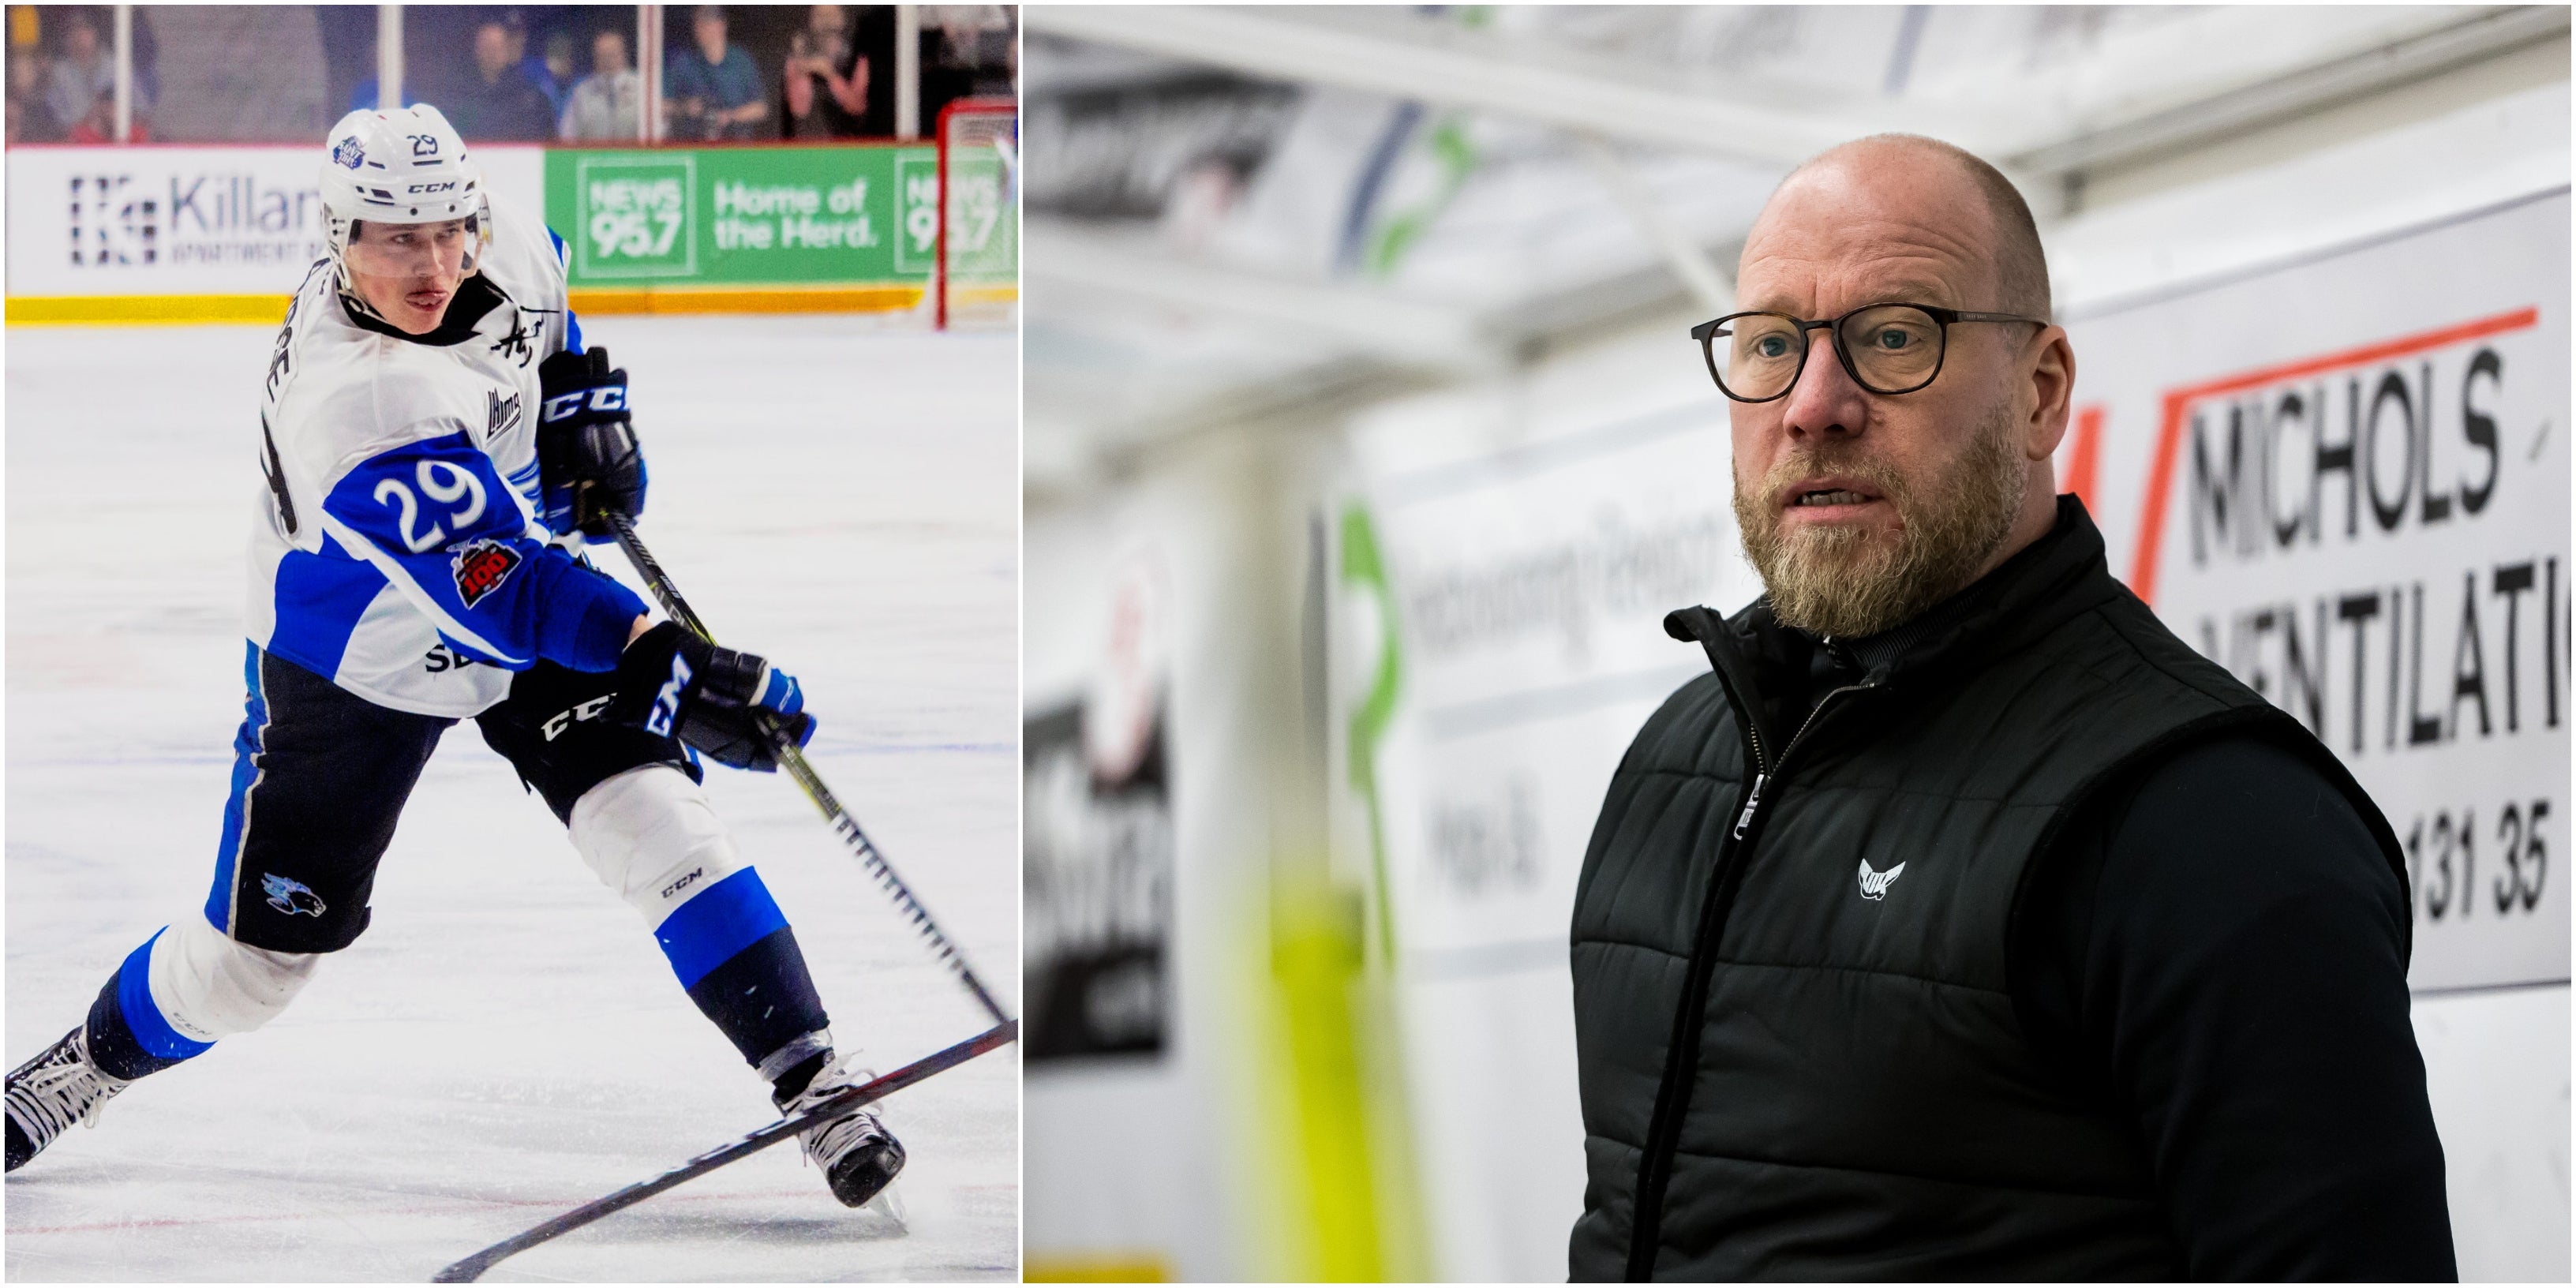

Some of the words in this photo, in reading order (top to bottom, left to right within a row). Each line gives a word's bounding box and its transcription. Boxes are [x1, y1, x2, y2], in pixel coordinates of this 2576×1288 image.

[406, 134, 438, 156] 29
[407, 182, 456, 194] CCM
[589, 179, 682, 211] NEWS
[713, 180, 821, 215] Home
[829, 177, 867, 215] of
[715, 219, 772, 249] the
[781, 215, 880, 248] Herd.
[543, 387, 631, 423] CC
[373, 455, 487, 554] 29
[464, 552, 508, 597] 100
[2198, 556, 2570, 755] ENTILATI
[541, 692, 618, 742] CC
[2492, 799, 2553, 917] 35
[661, 867, 702, 898] CCM
